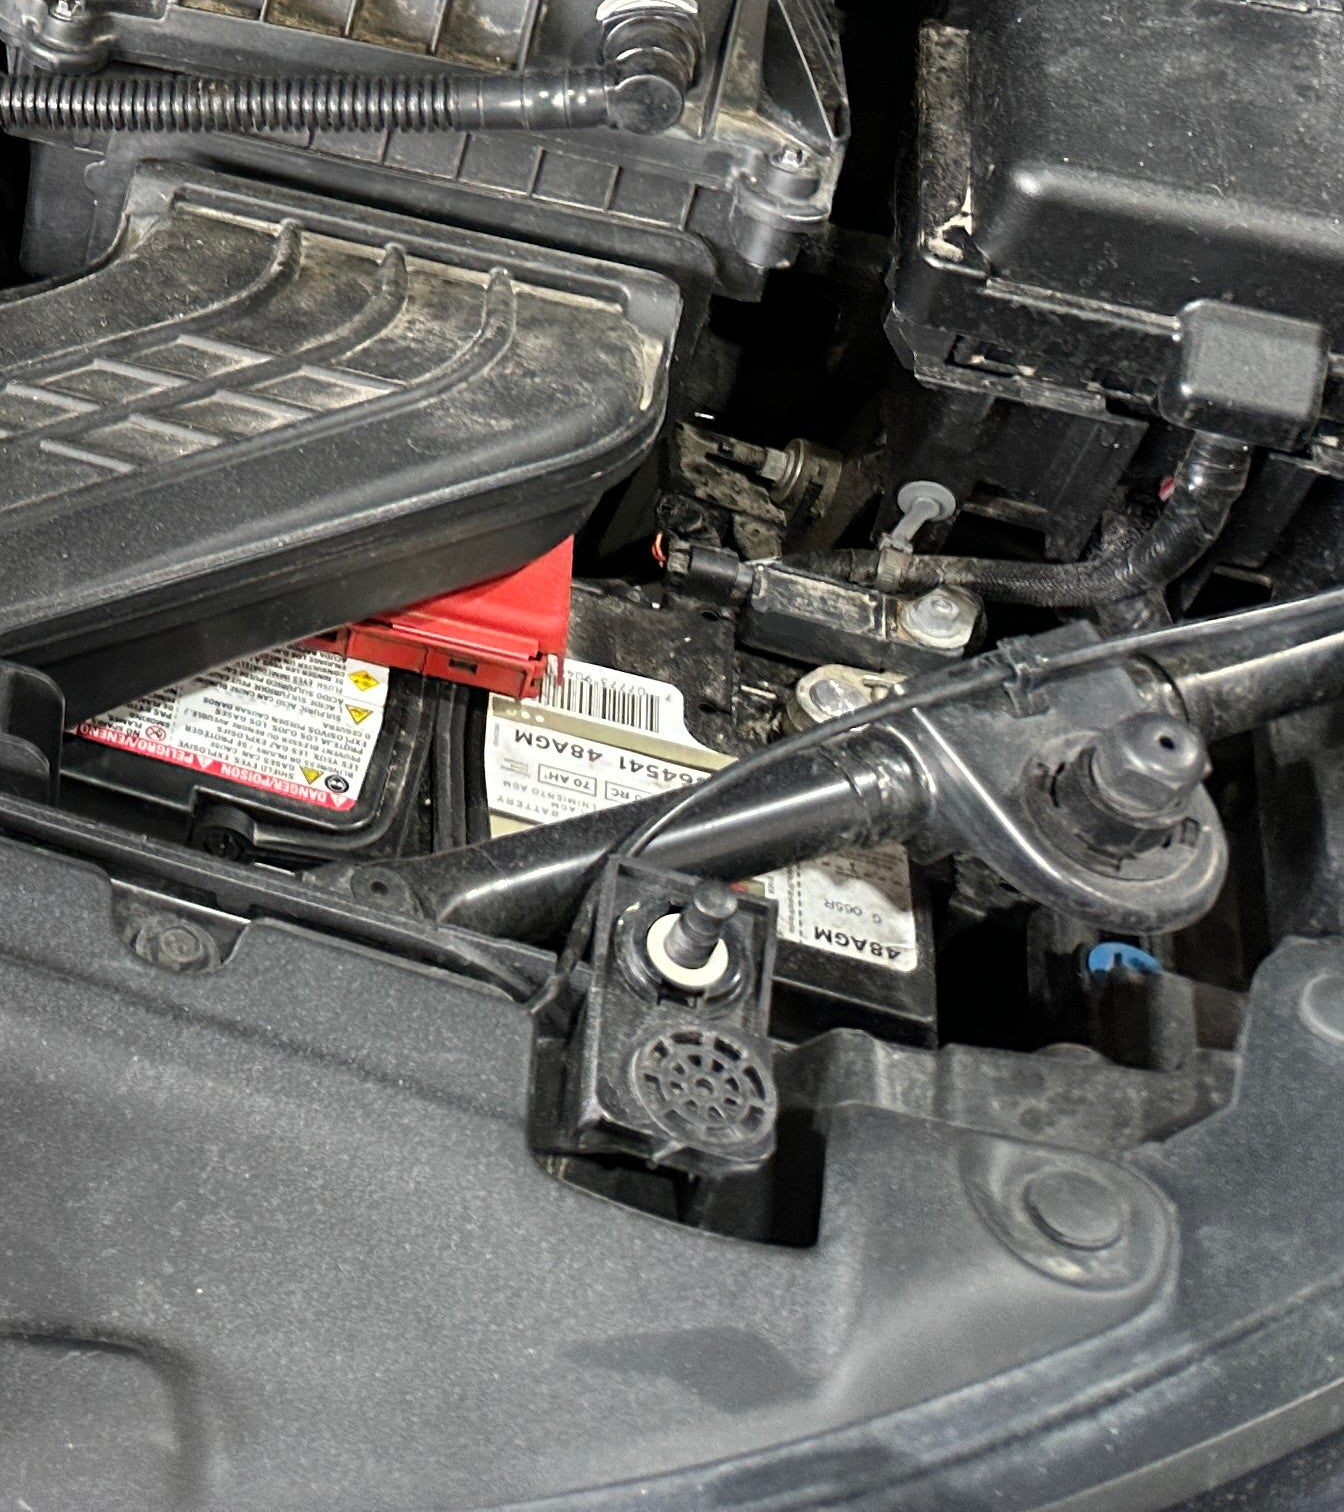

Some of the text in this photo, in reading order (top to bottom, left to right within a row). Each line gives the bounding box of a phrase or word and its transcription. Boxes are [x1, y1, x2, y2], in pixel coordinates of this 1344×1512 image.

[567, 670, 591, 683] 904
[515, 729, 602, 762] 48AGM
[619, 756, 704, 786] 64541
[221, 764, 326, 803] DANGER/POISON
[503, 780, 527, 791] AGM
[574, 778, 590, 790] 70
[610, 788, 629, 800] RC
[496, 795, 558, 817] BATTERY
[814, 926, 900, 959] 48AGM
